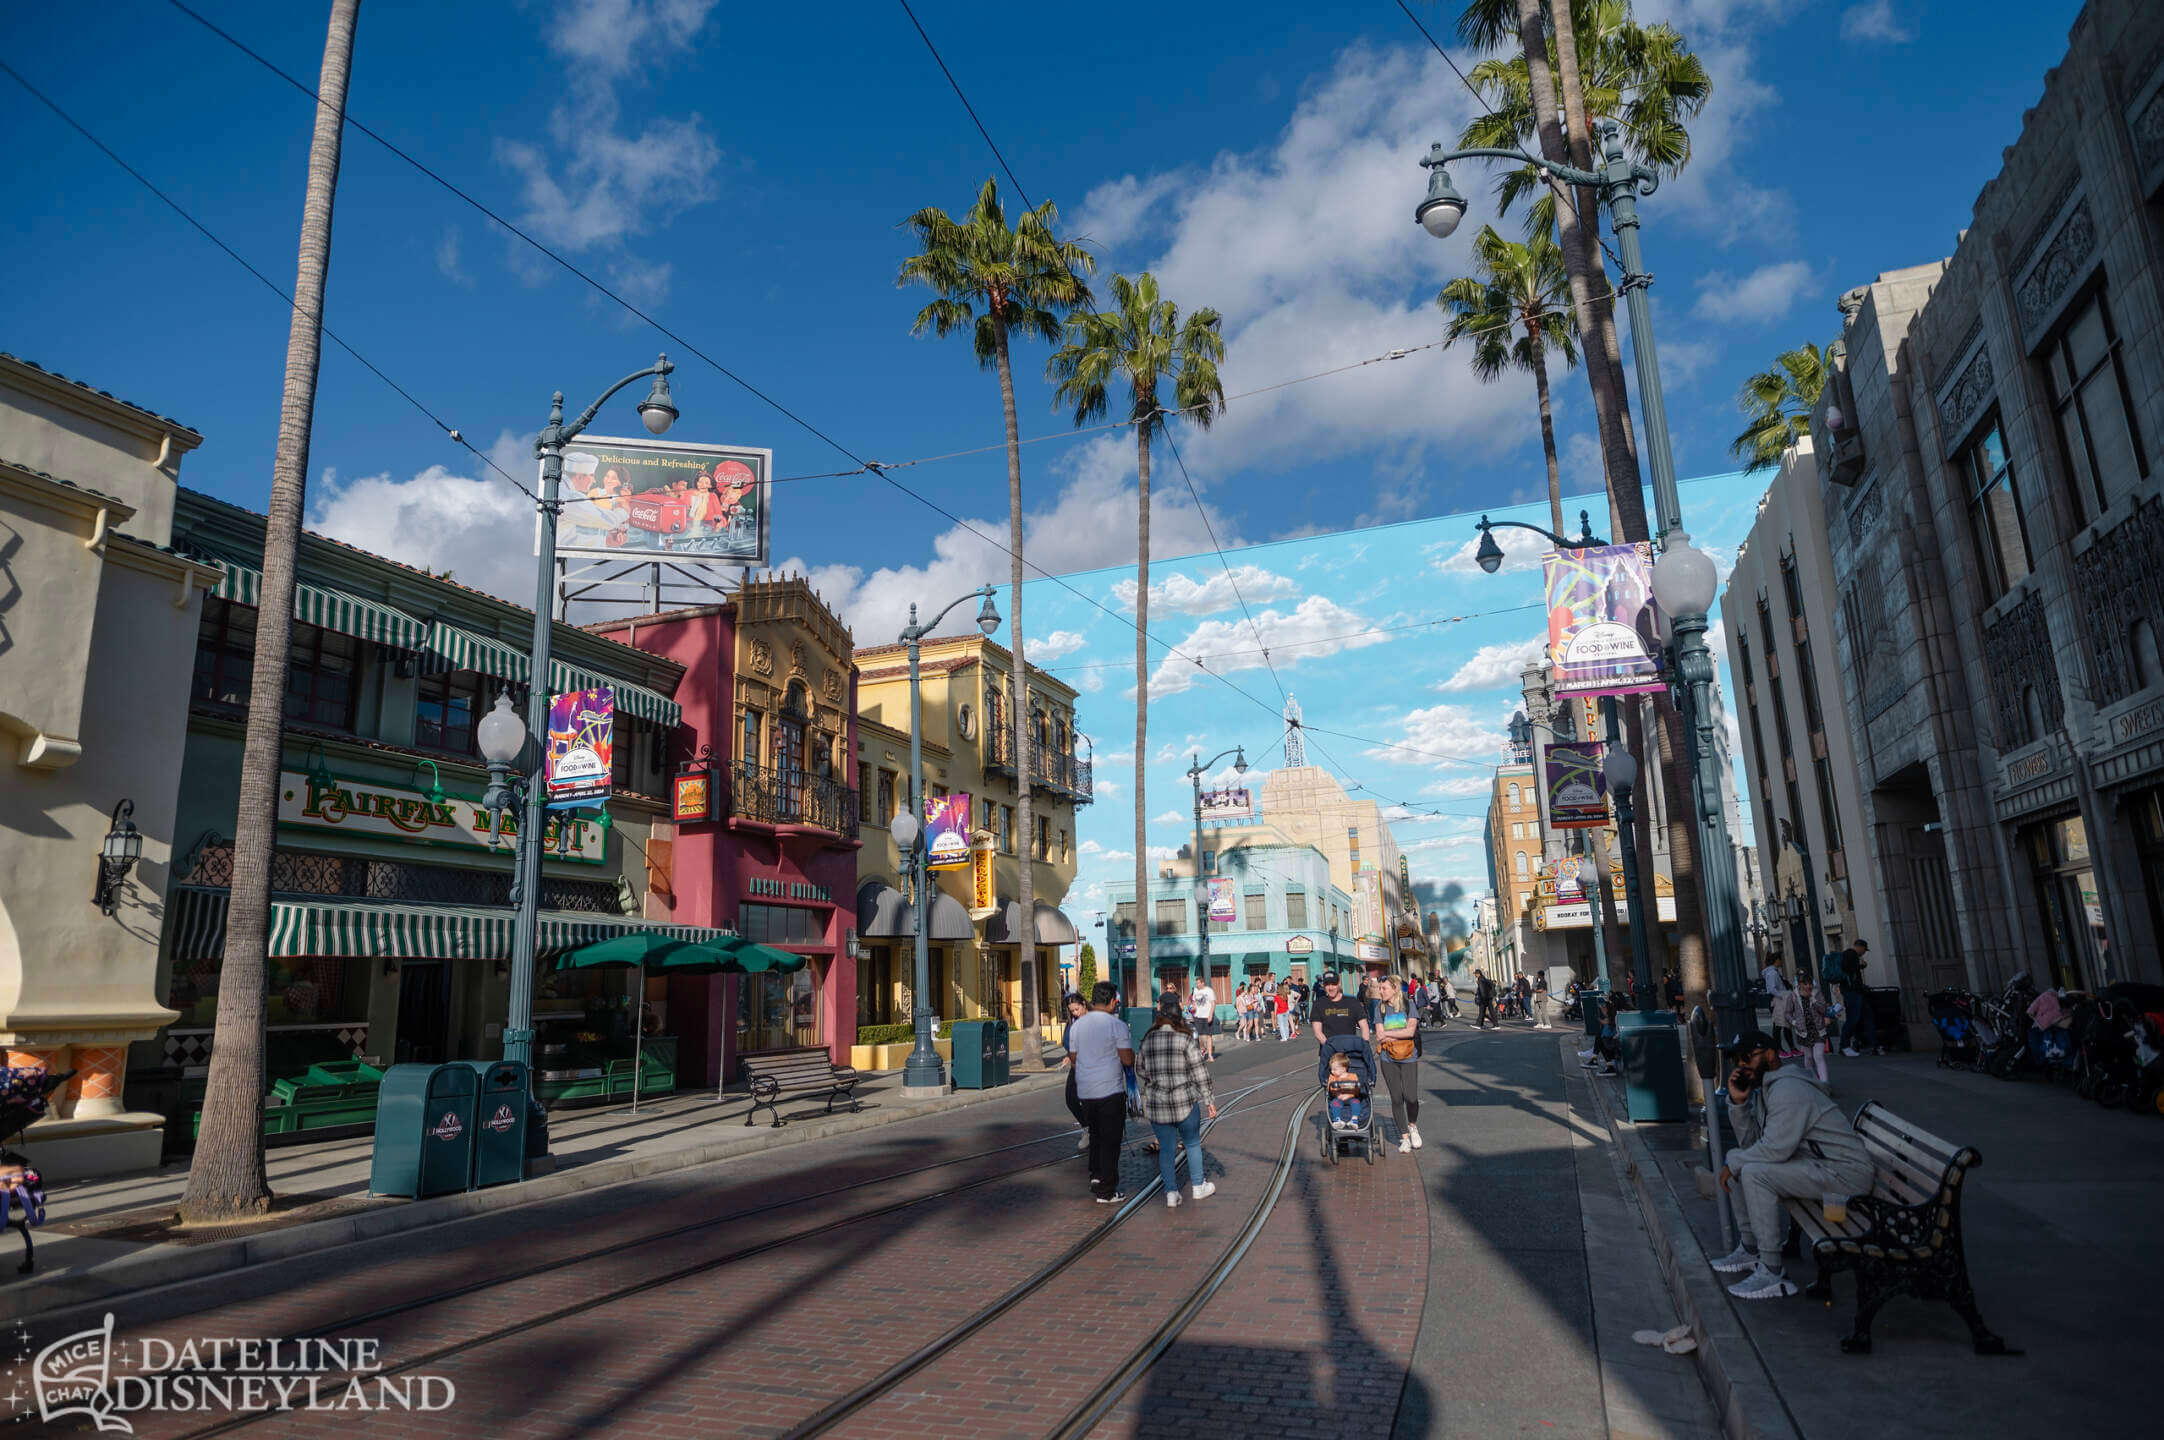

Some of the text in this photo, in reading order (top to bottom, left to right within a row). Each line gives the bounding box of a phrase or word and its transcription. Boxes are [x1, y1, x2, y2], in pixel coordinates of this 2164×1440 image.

[643, 458, 659, 467] and
[1576, 644, 1603, 654] FOOD
[1610, 641, 1635, 650] WINE
[302, 781, 457, 833] FAIRFAX
[749, 877, 785, 898] ARGYLE
